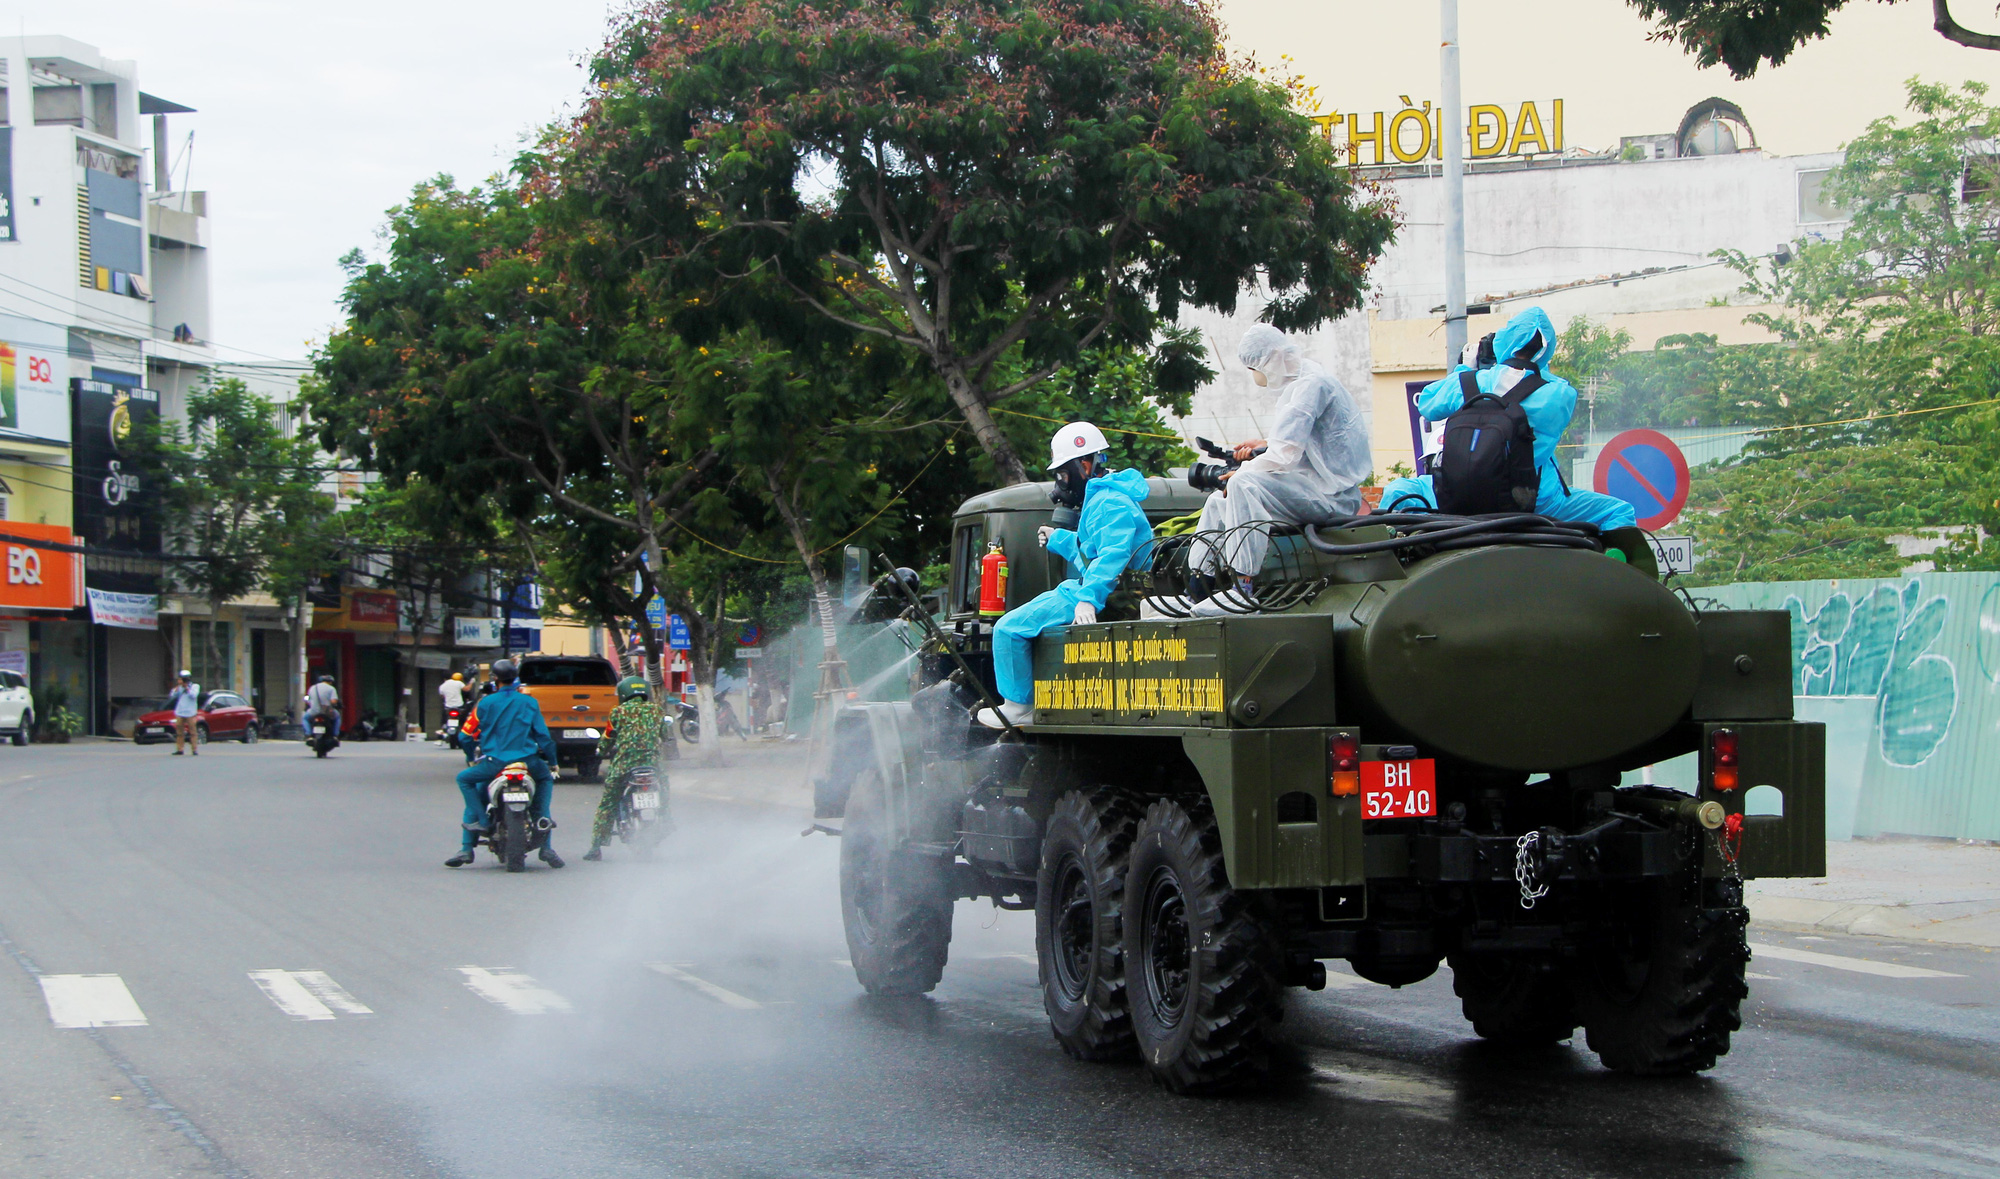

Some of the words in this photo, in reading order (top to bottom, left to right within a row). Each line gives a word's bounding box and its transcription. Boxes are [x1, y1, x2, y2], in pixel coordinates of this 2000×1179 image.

[29, 356, 53, 384] BQ
[102, 460, 140, 505] Spa
[8, 547, 43, 584] BQ
[1115, 640, 1129, 667] HỌC
[1133, 634, 1144, 666] BỘ
[1145, 631, 1162, 663] QUỐC
[1384, 762, 1411, 788] BH
[1366, 790, 1430, 816] 52-40
